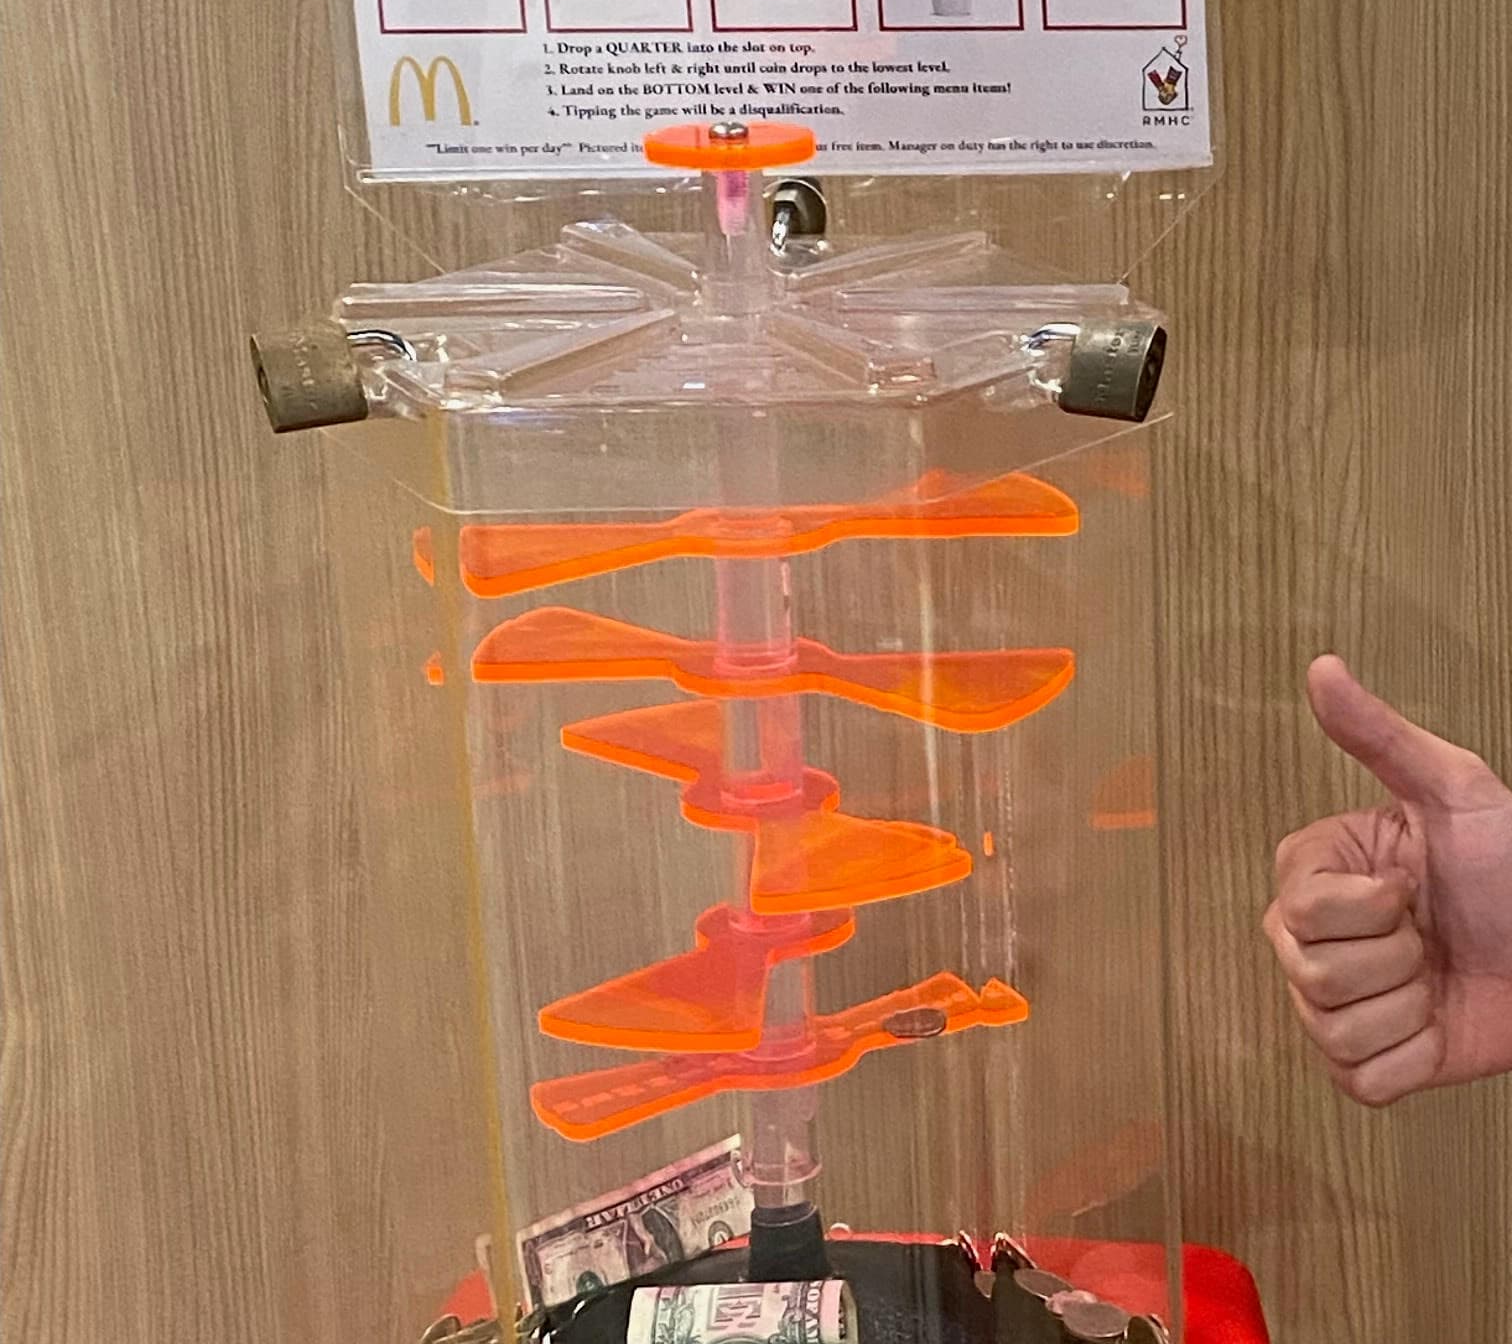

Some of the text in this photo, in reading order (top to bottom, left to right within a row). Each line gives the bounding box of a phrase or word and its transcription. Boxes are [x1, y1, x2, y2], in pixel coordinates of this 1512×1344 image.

[557, 42, 592, 57] Drop
[606, 42, 683, 57] QUARTER
[687, 41, 714, 54] into
[718, 41, 738, 53] the
[742, 41, 765, 53] slot
[769, 44, 786, 53] on
[789, 42, 815, 56] top.
[559, 63, 603, 75] Rotate
[608, 63, 641, 74] knob
[645, 62, 666, 74] left
[671, 64, 683, 74] &
[687, 63, 720, 77] right
[724, 62, 756, 74] until
[759, 62, 787, 74] coin
[791, 61, 827, 76] drops
[831, 63, 845, 73] to
[848, 61, 869, 73] the
[872, 61, 914, 73] lowest
[561, 84, 594, 96] Land
[599, 86, 614, 96] on
[618, 84, 638, 95] the
[643, 83, 710, 96] BOTTOM
[714, 83, 744, 95] level
[747, 83, 759, 95] &
[763, 83, 796, 95] WIN
[800, 86, 823, 94] one
[826, 82, 843, 94] of
[844, 82, 864, 94] the
[868, 82, 930, 97] following
[933, 85, 969, 94] menu
[972, 82, 1012, 94] items!
[563, 105, 617, 119] Tipping
[620, 105, 641, 116] the
[645, 107, 678, 119] game
[682, 104, 707, 116] will
[711, 104, 726, 115] be
[739, 103, 845, 120] disqualification.
[1142, 115, 1190, 126] RMHC
[496, 143, 518, 154] win
[579, 142, 628, 154] Pictured
[888, 140, 937, 154] Manager
[940, 143, 955, 151] on
[958, 140, 984, 154] duty
[1009, 140, 1028, 151] the
[1030, 140, 1058, 154] right
[1062, 141, 1073, 150] to
